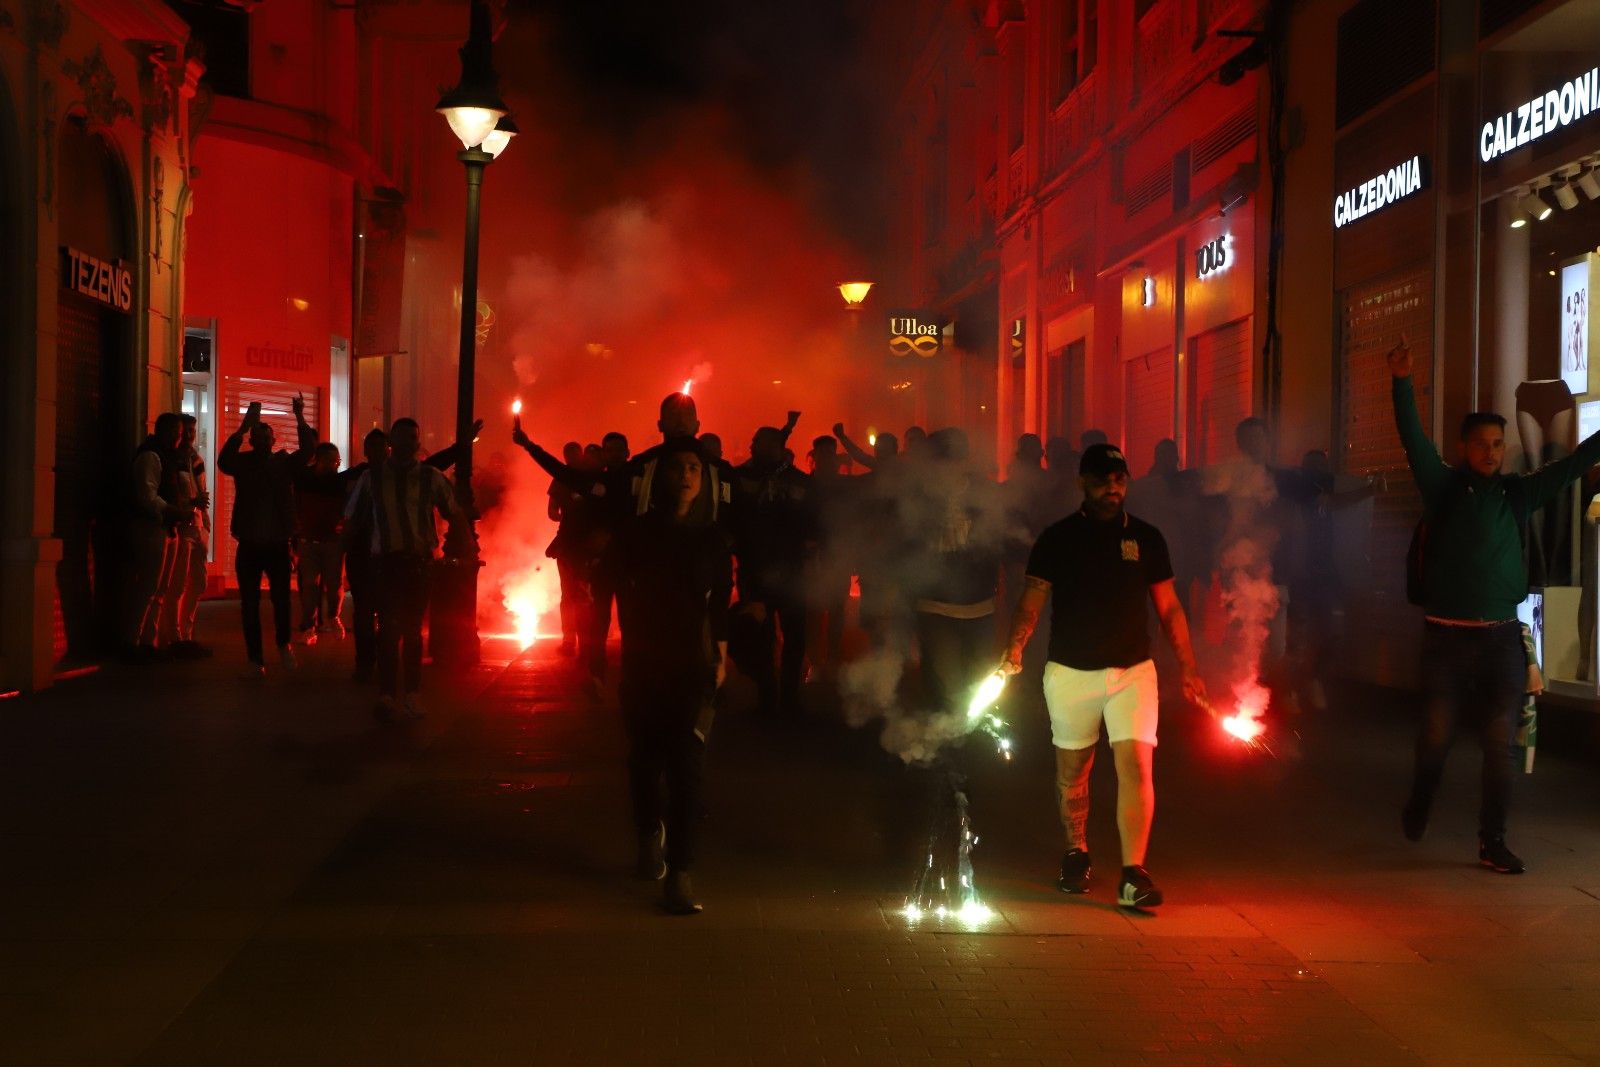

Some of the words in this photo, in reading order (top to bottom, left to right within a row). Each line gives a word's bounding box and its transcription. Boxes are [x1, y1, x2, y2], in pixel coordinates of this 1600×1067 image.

[1480, 67, 1600, 162] CALZEDONI
[1334, 155, 1421, 228] CALZEDONIA
[68, 247, 131, 310] TEZENIS
[1195, 235, 1227, 278] TOUS
[889, 318, 938, 336] Ulloa
